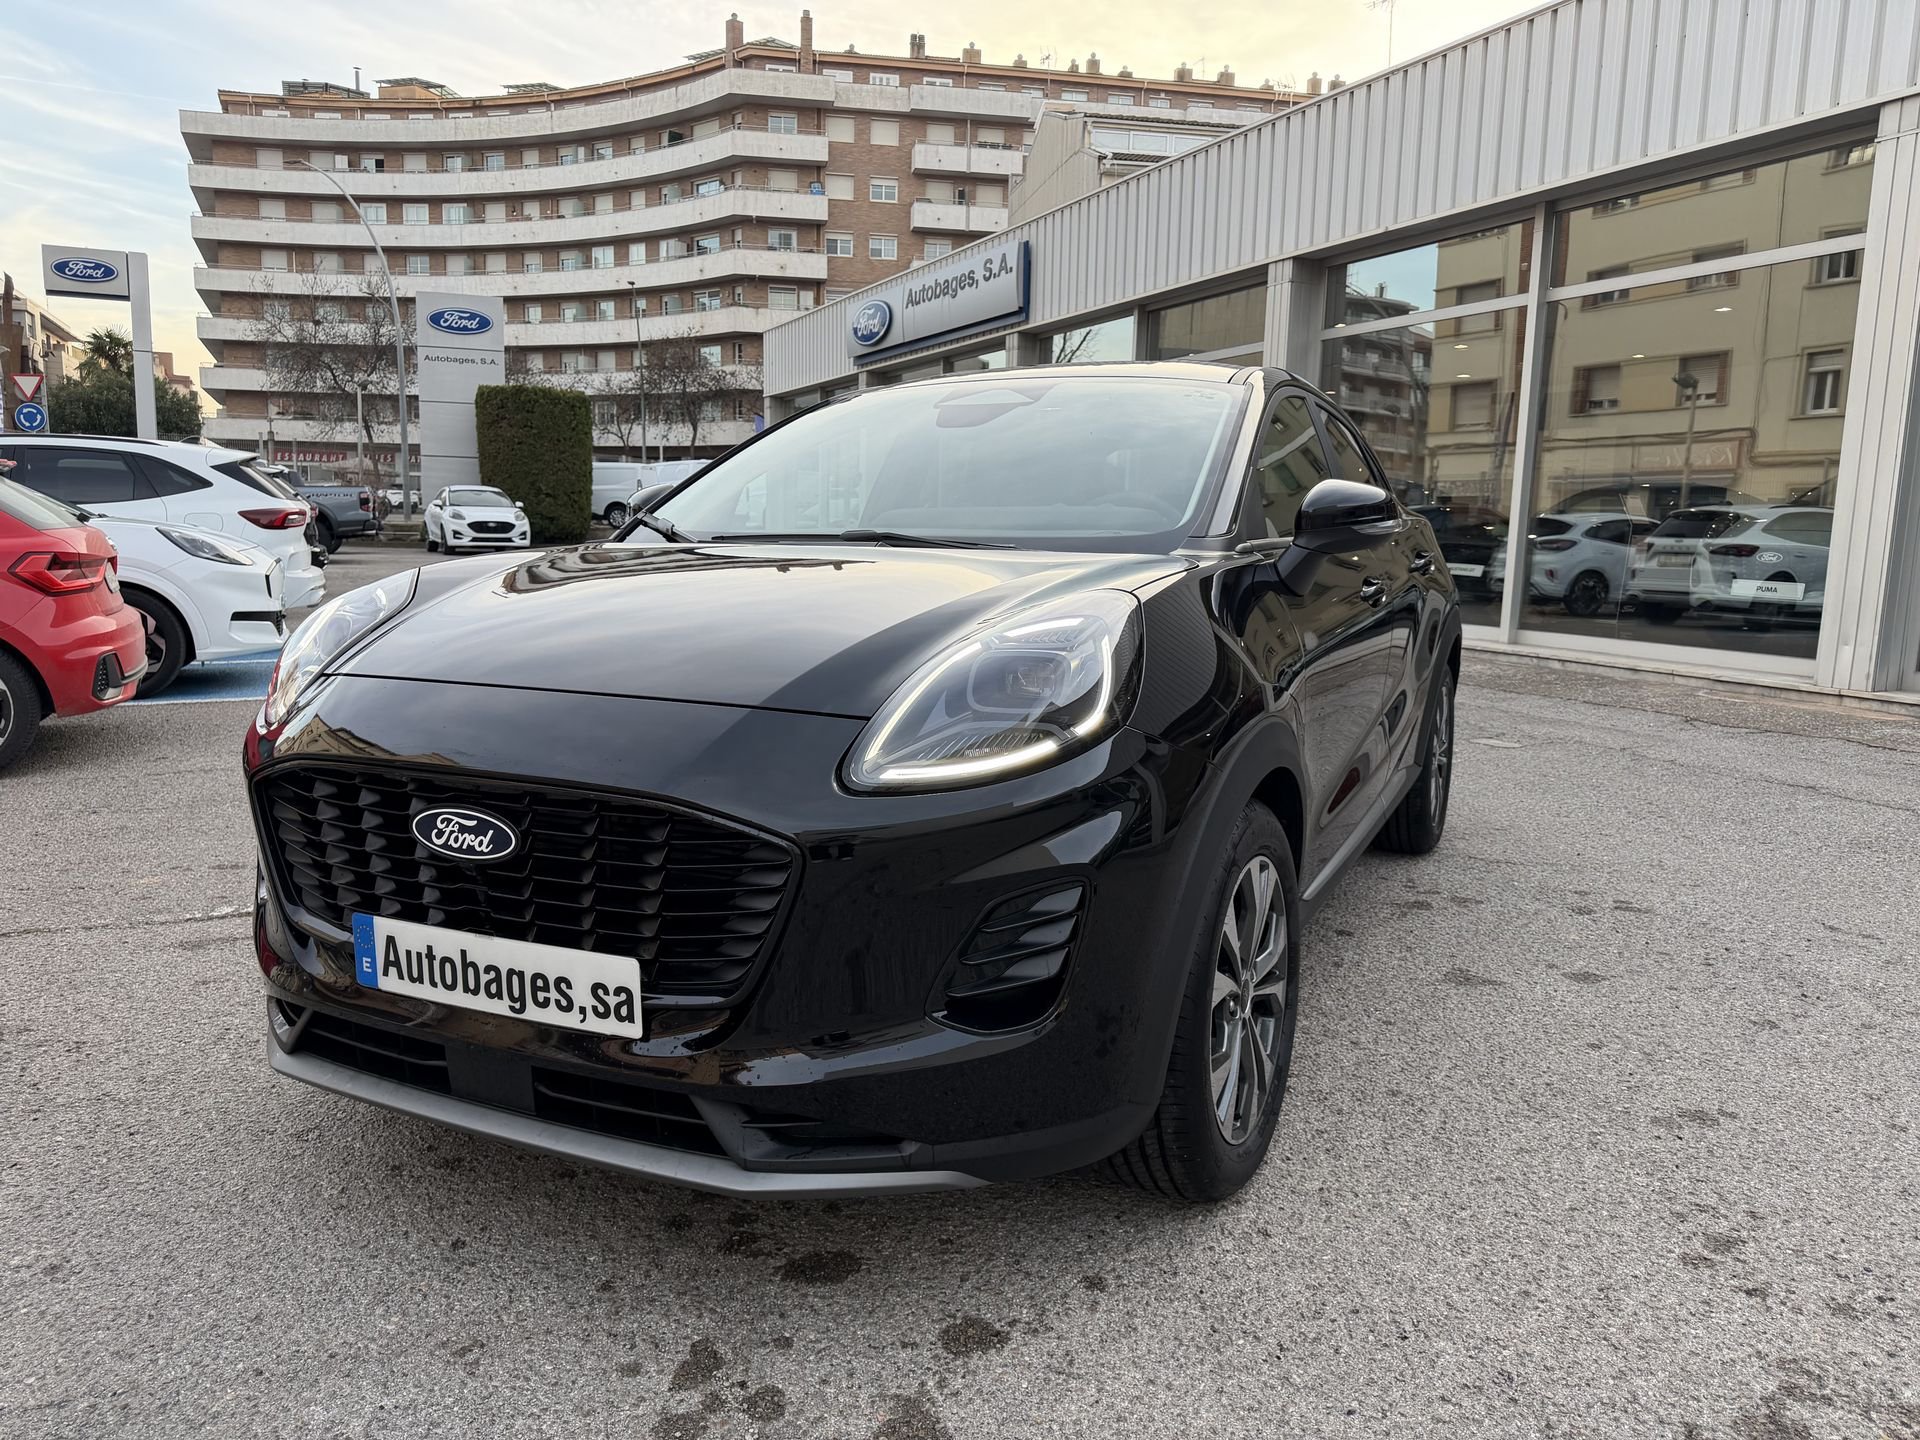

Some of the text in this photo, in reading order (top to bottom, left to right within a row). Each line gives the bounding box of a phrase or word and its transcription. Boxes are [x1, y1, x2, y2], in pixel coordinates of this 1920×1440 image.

[65, 261, 105, 278] Ford
[905, 252, 1014, 309] Autobages, S.A.
[440, 311, 480, 329] Ford
[857, 308, 881, 337] Ford
[423, 354, 499, 366] Autobages, S.A.
[273, 452, 345, 463] ESAURANT
[1755, 585, 1778, 593] PUMA
[431, 814, 494, 854] Ford
[362, 957, 372, 973] E
[381, 934, 636, 1025] Autobages,sa
